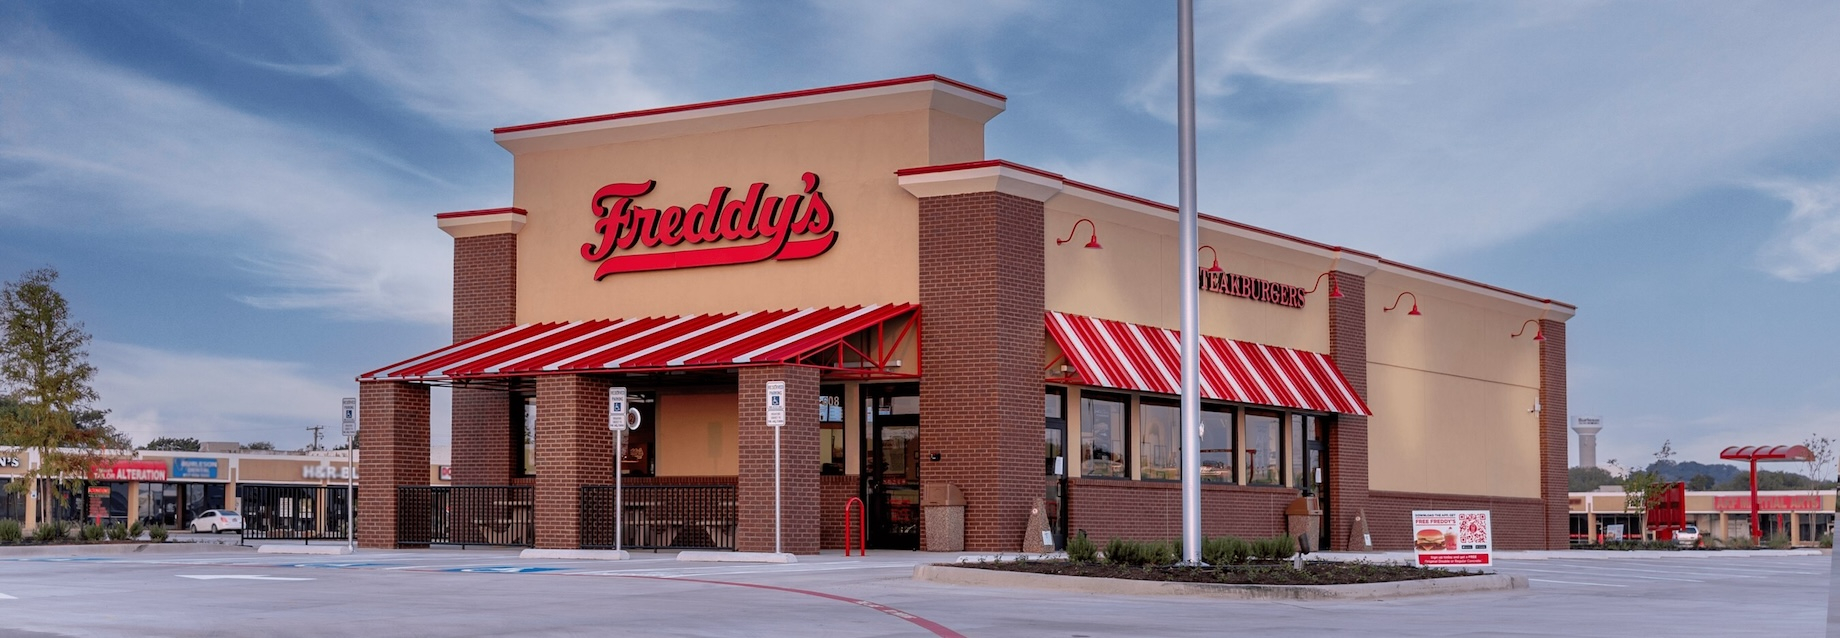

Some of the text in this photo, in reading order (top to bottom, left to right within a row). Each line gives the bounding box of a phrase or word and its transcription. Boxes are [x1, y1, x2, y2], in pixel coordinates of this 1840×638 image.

[581, 172, 839, 281] Freddy's
[1199, 266, 1306, 309] TEAKBURGERS
[116, 468, 166, 480] ALTERATION
[1740, 497, 1787, 509] MRTIAL
